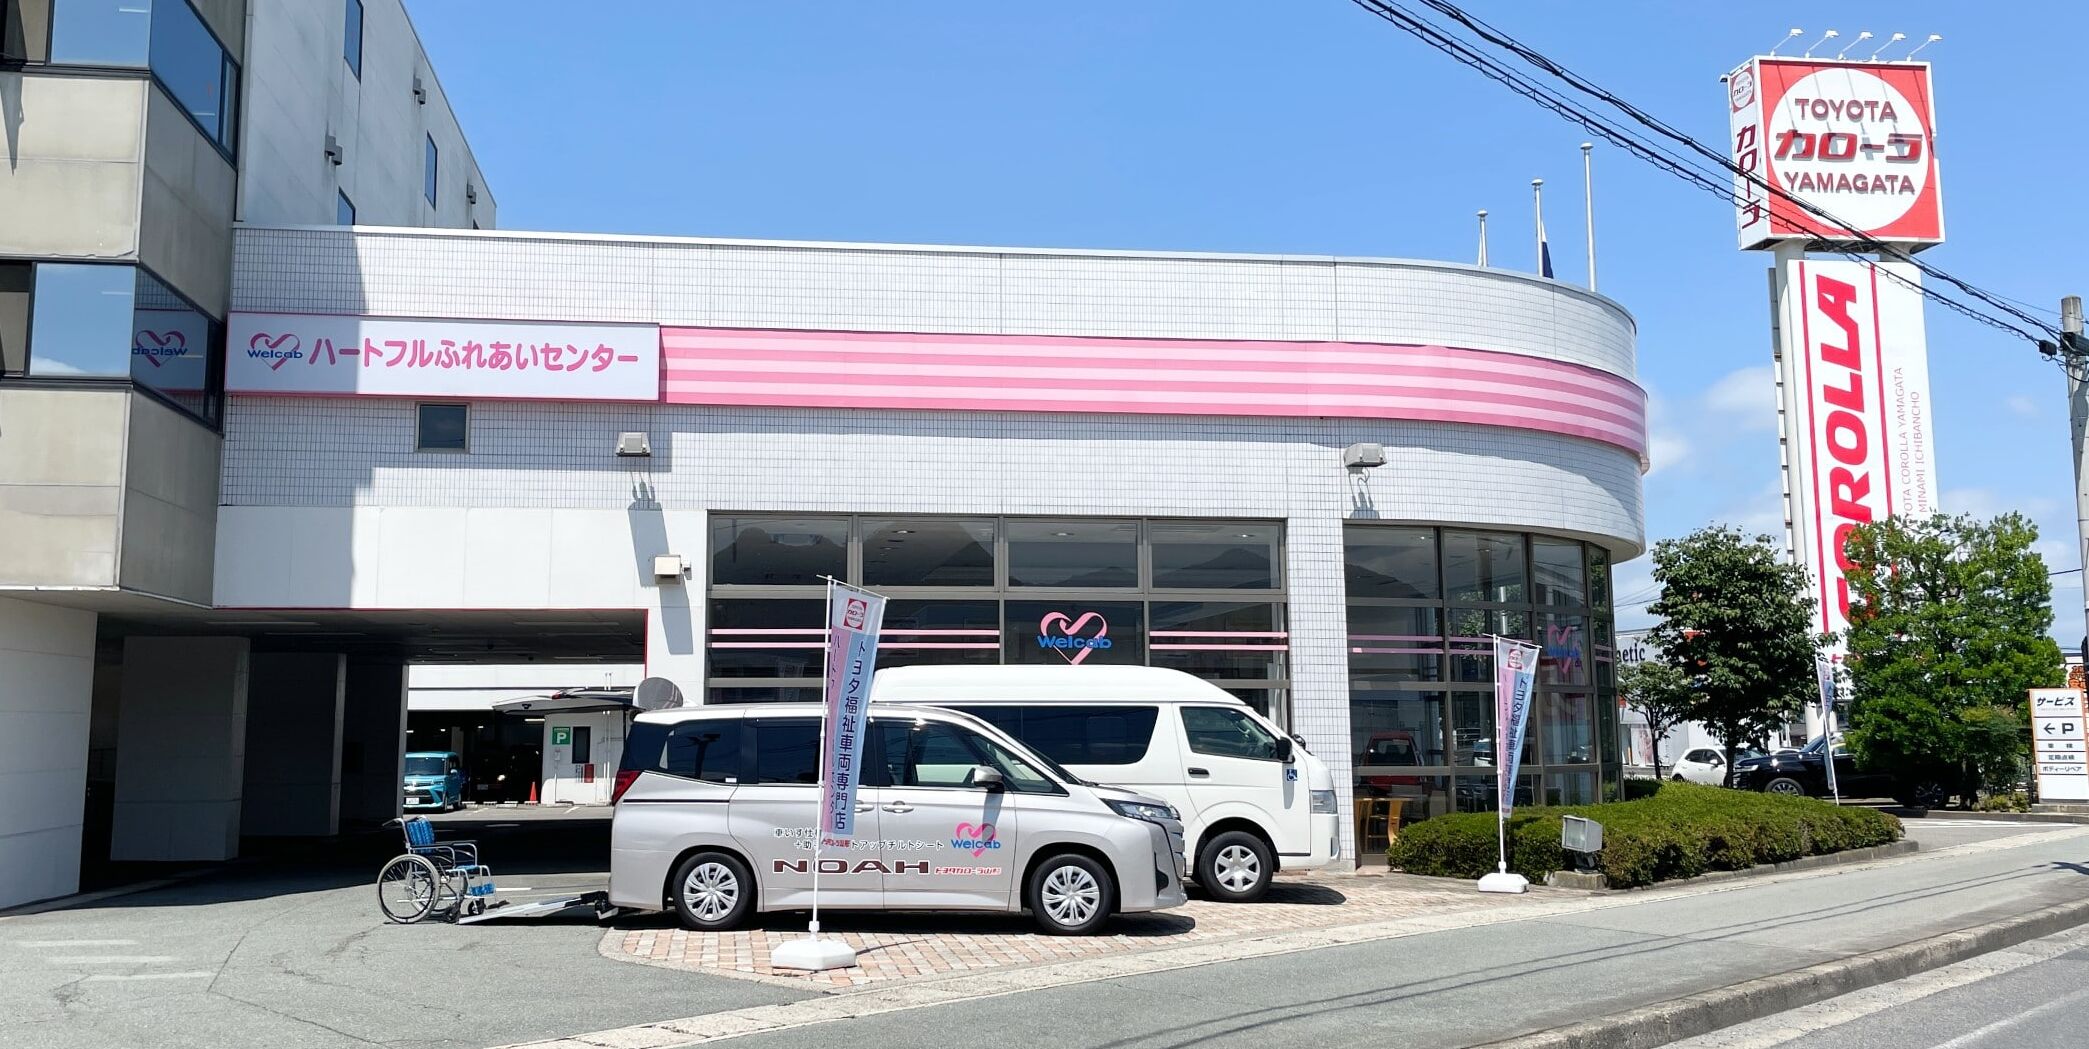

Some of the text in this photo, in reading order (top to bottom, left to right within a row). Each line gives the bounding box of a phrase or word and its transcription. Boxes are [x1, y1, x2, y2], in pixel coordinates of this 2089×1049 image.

[1795, 98, 1898, 123] TOYOTA
[1774, 129, 1923, 164] カローラ
[1736, 123, 1761, 230] カローラ
[1784, 172, 1916, 196] YAMAGATA
[247, 337, 639, 373] Welcab ハートフルふれあいセンター
[1894, 367, 1907, 430] YAMAGATA
[1899, 431, 1912, 485] COROLLA
[1910, 391, 1928, 513] MINAMI ICHIBANCHO
[1036, 634, 1113, 650] Welcab
[2036, 696, 2076, 707] サービス
[556, 732, 567, 744] P
[834, 640, 867, 831] トヨタ福祉車両専門店
[2061, 722, 2075, 735] P
[950, 838, 1001, 850] Welcab
[773, 859, 930, 874] NOAH
